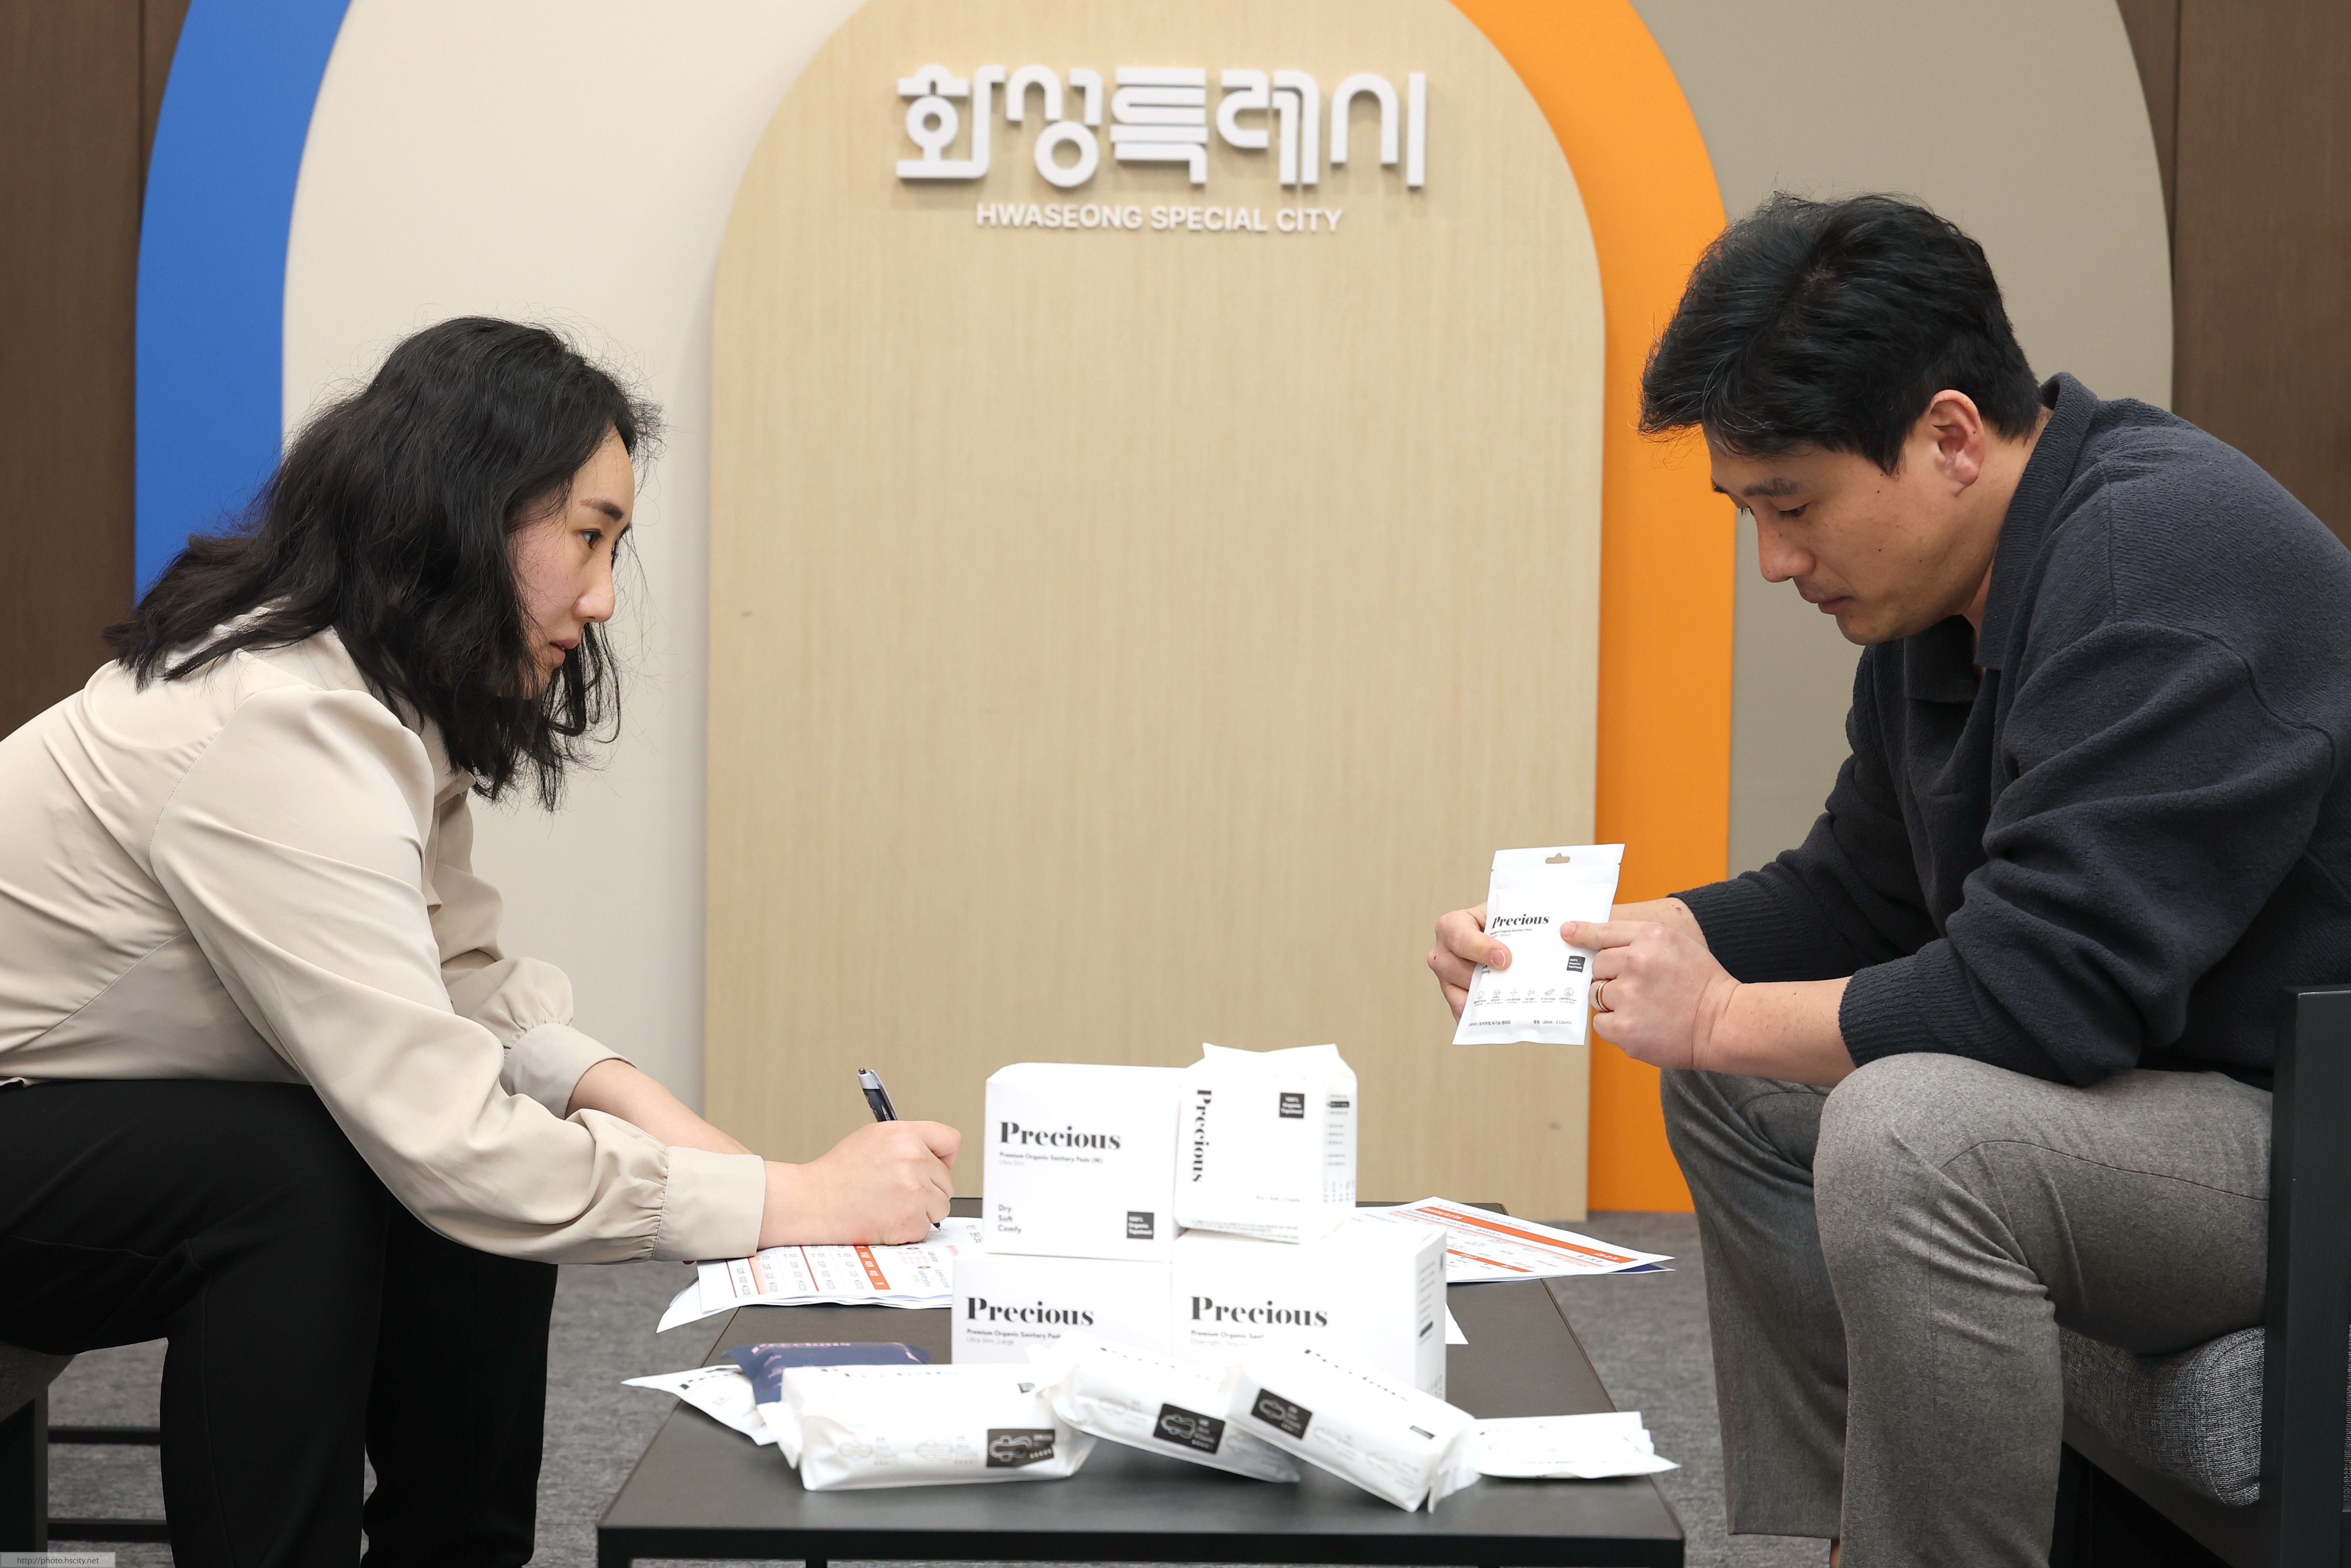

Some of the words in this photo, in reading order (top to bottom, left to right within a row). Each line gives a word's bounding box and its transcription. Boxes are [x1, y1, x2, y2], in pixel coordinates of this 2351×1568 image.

[896, 63, 1427, 187] 화성특례시
[977, 203, 1143, 229] HWASEONG
[1150, 205, 1269, 232] SPECIAL
[1276, 207, 1343, 232] CITY
[1492, 913, 1550, 929] Precious
[999, 1121, 1122, 1150] Precious
[1192, 1089, 1213, 1182] Precious
[998, 1204, 1012, 1213] Dry
[997, 1224, 1022, 1235] Comfy
[966, 1296, 1094, 1326] Precious
[1190, 1296, 1328, 1327] Precious
